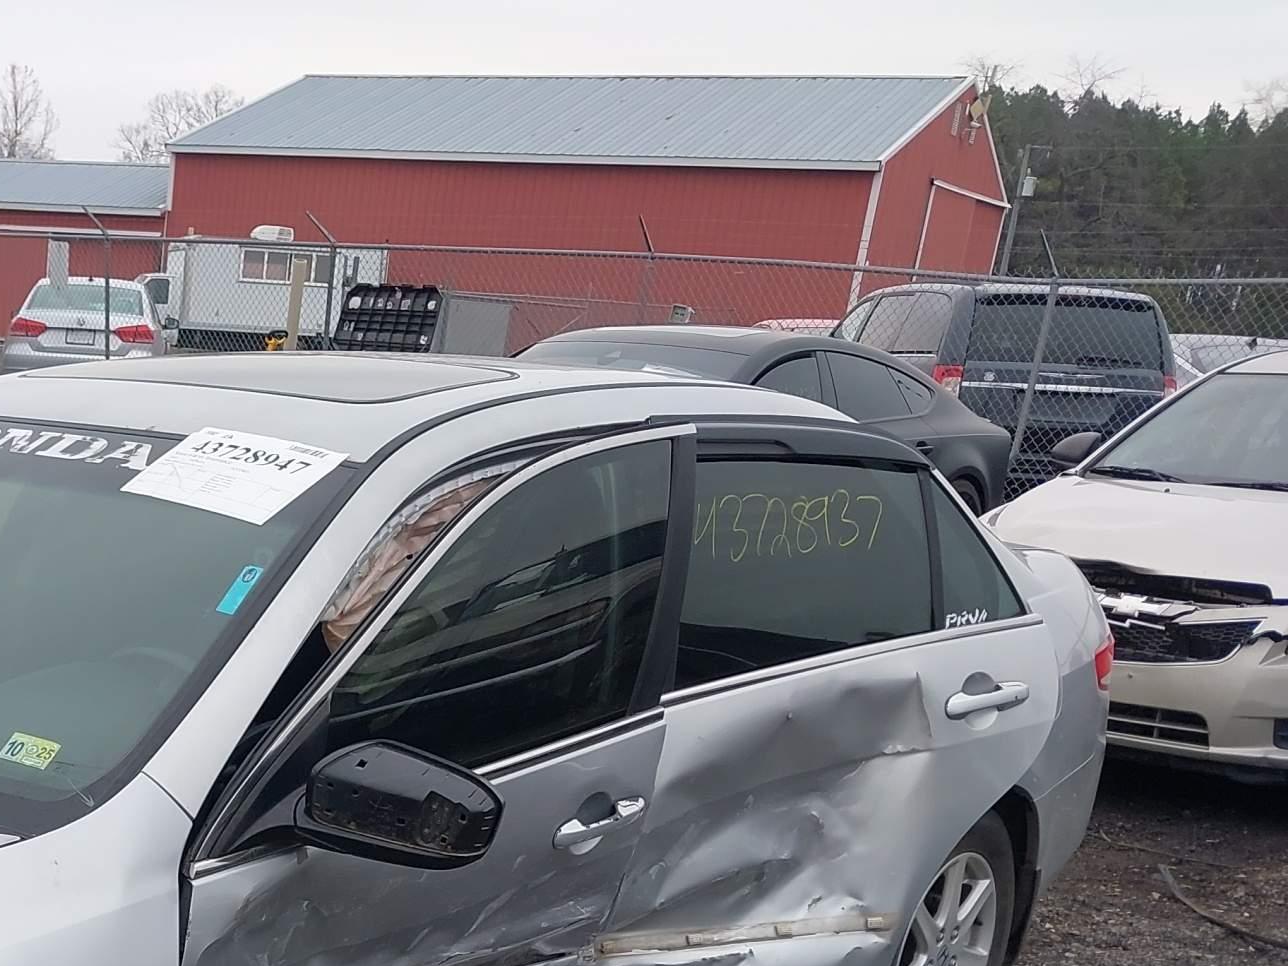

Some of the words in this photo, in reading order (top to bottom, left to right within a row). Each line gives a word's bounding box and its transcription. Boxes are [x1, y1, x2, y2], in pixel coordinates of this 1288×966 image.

[191, 440, 312, 475] 43728947
[694, 489, 883, 562] 43728937
[5, 740, 25, 757] 10
[35, 747, 56, 761] 25
